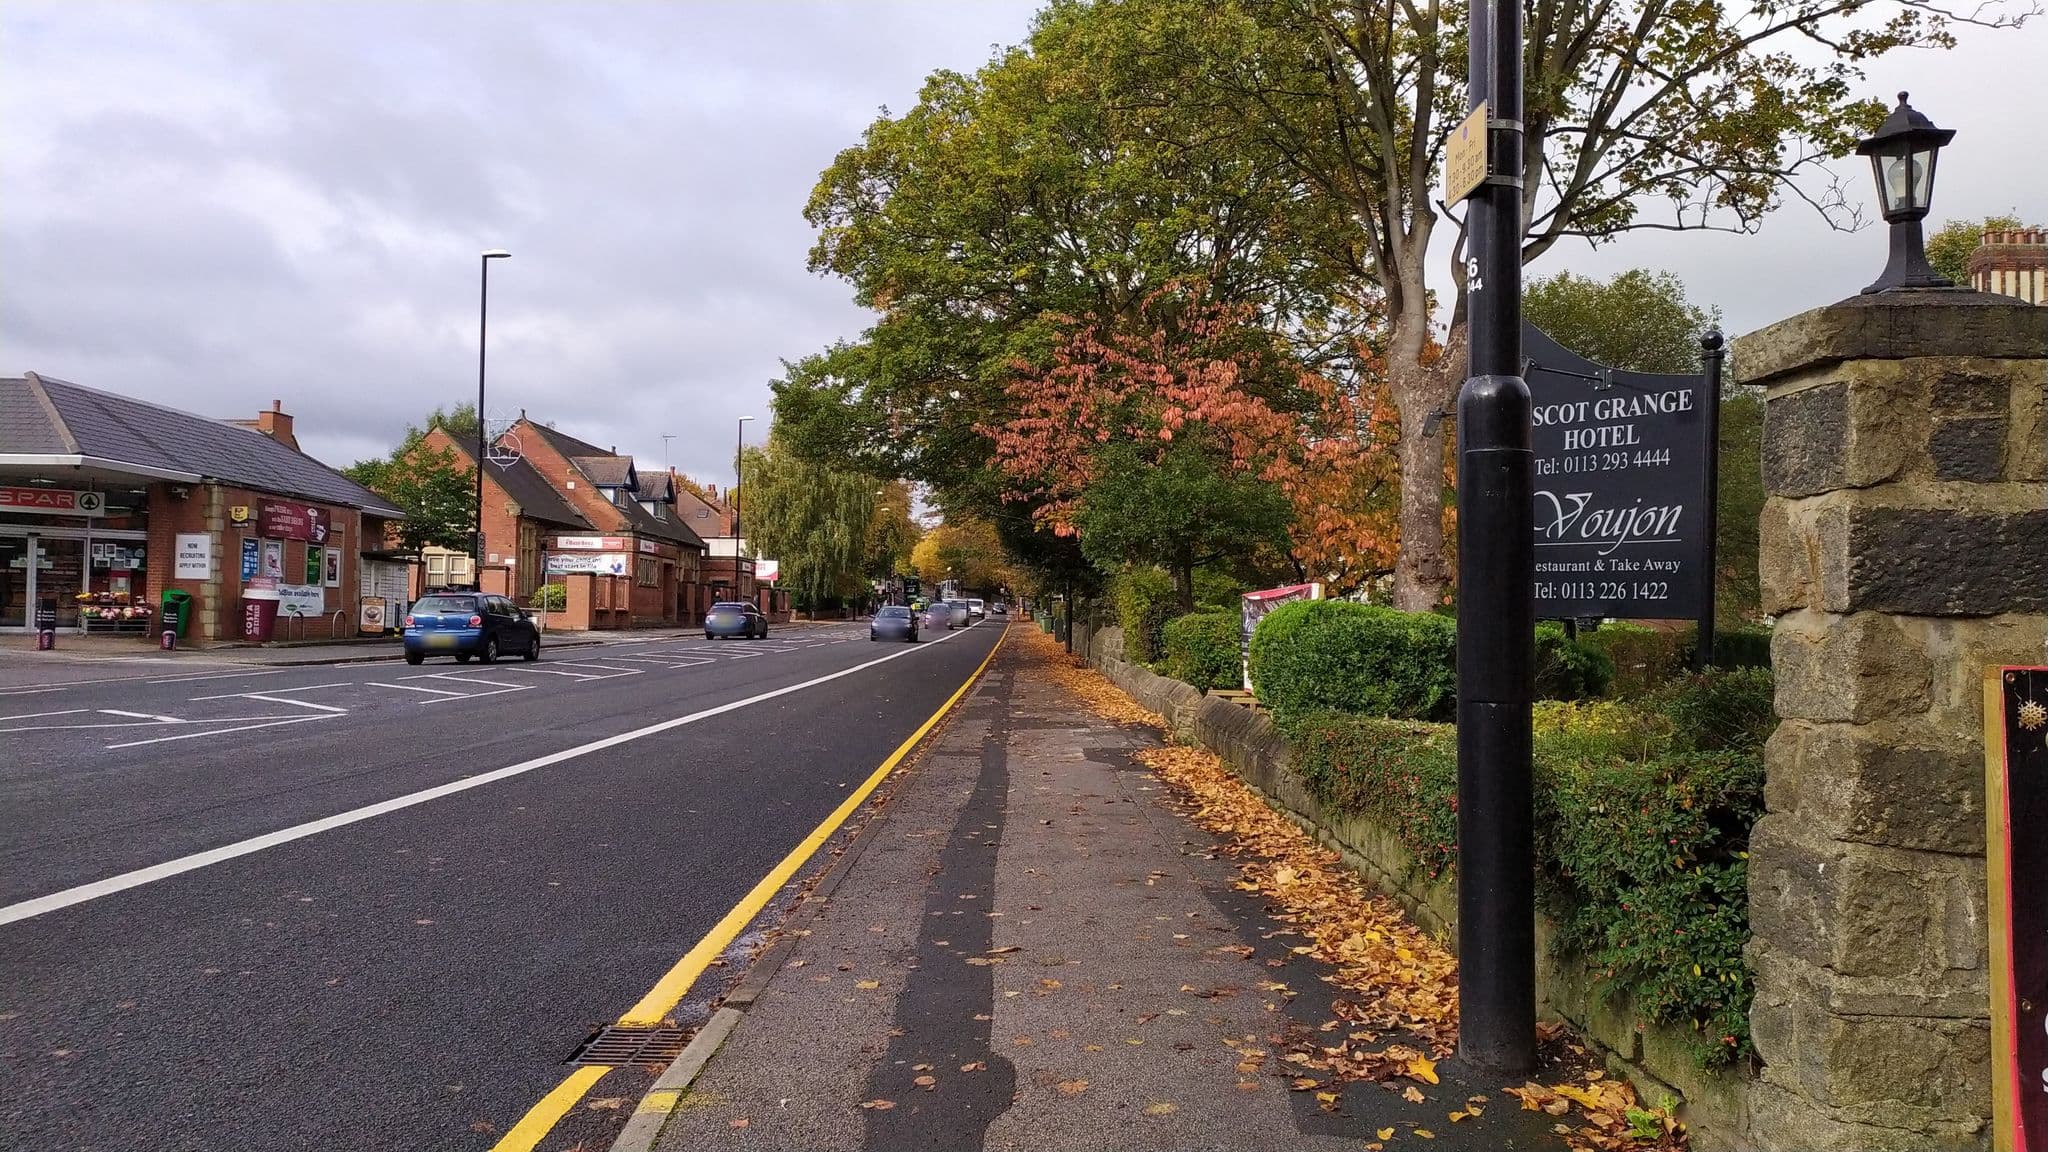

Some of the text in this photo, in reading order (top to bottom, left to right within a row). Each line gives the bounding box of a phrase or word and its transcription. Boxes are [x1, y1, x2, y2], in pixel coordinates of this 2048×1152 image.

[1455, 149, 1466, 164] Mon
[1532, 389, 1693, 426] SCOT GRANGE
[1563, 424, 1640, 450] HOTEL
[1535, 448, 1671, 475] Tel: 0113 293 4444
[0, 492, 73, 506] SPAR
[1534, 490, 1683, 556] Voujon
[1535, 558, 1681, 574] estaurant & Take Away
[1534, 582, 1668, 600] Tel: 0113 226 1422
[245, 604, 254, 635] COSTA
